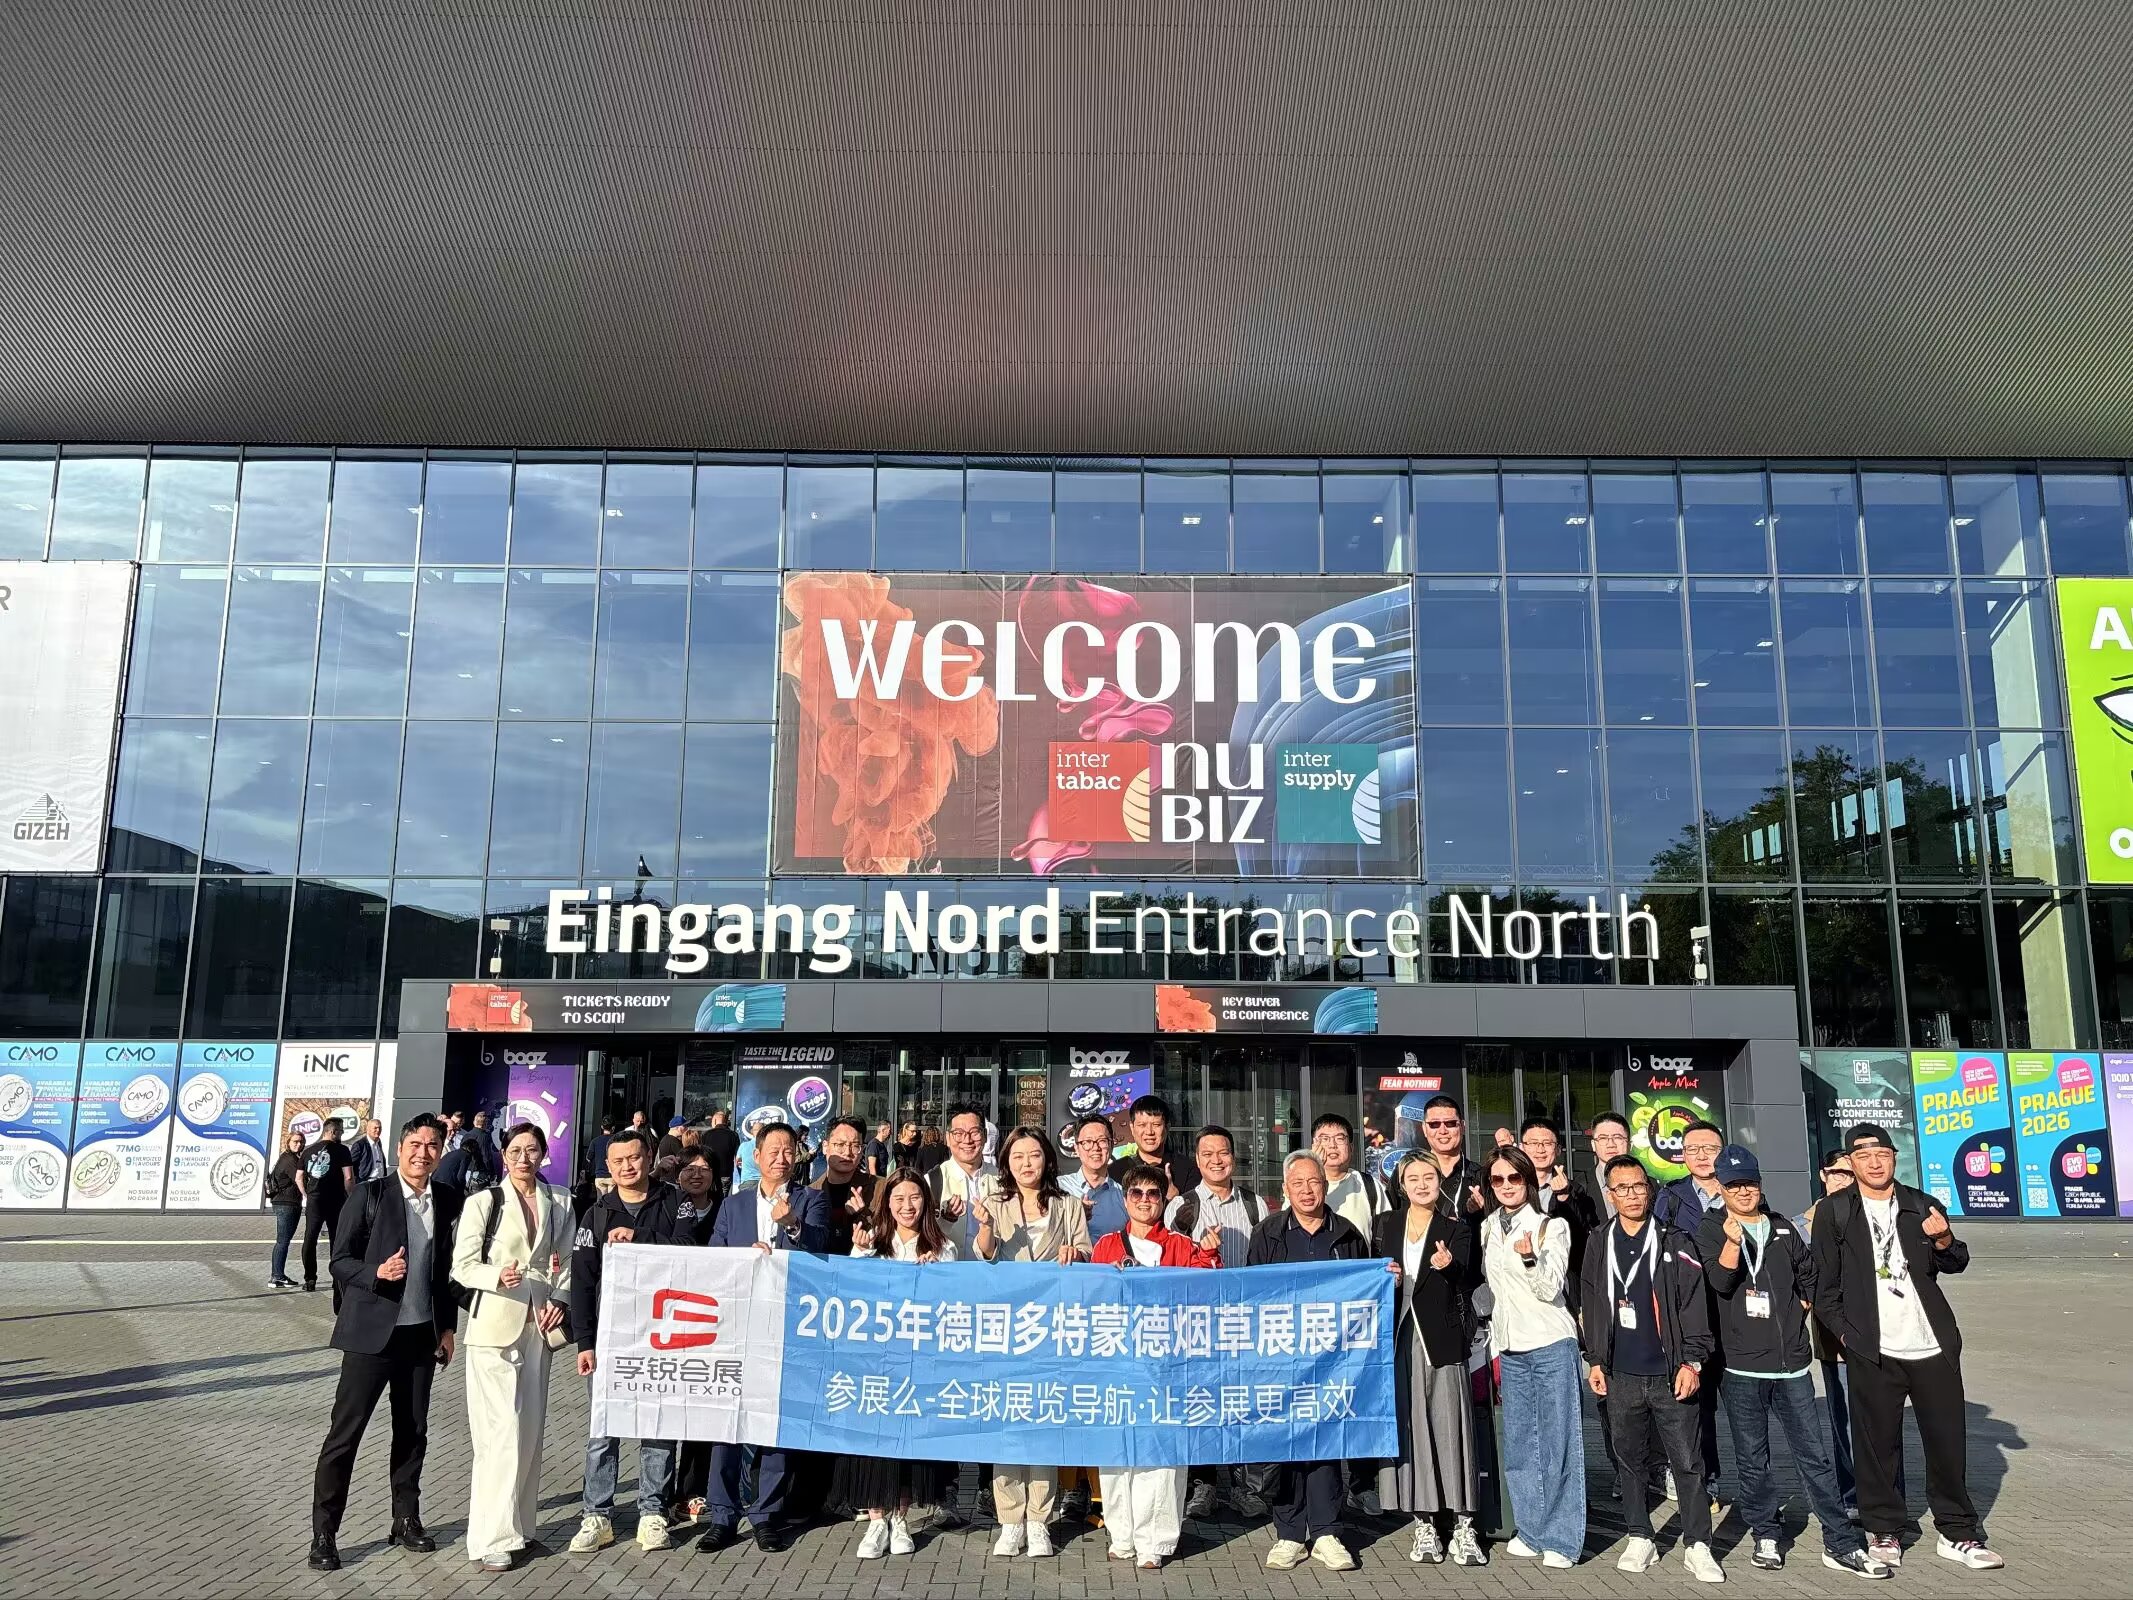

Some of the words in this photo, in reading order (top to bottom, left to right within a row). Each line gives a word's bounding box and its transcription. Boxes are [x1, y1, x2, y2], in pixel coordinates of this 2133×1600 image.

[2089, 606, 2133, 650] A
[1056, 749, 1110, 768] inter
[1283, 750, 1332, 767] inter
[1056, 771, 1121, 790] tabac
[1283, 771, 1357, 791] supply
[1161, 794, 1265, 843] BIZ
[13, 823, 70, 841] GIZEH
[545, 886, 855, 974] Eingang
[884, 887, 1060, 955] Nord
[1087, 889, 1421, 959] Entrance
[1450, 893, 1661, 961] North
[562, 995, 622, 1007] TICKETS
[715, 1000, 738, 1009] supply
[1222, 997, 1243, 1007] KEY
[1245, 997, 1281, 1007] BUYER
[561, 1012, 581, 1024] TO
[1222, 1010, 1237, 1020] CB
[1238, 1010, 1310, 1020] CONFERENCE
[8, 1046, 58, 1061] CAMO
[106, 1046, 155, 1061] CAMO
[203, 1047, 254, 1061] CAMO
[504, 1049, 547, 1069] bagz
[744, 1047, 767, 1056] TASTE
[768, 1046, 783, 1056] THE
[780, 1047, 835, 1062] LEGEND
[303, 1054, 350, 1072] iNIC
[1070, 1047, 1130, 1075] bagz
[1650, 1055, 1693, 1076] bagz
[1855, 1062, 1868, 1074] CB
[1069, 1069, 1106, 1077] ENERGY
[1382, 1079, 1402, 1088] FEAR
[1403, 1079, 1438, 1088] NOTHING
[1648, 1076, 1672, 1090] Apple
[1675, 1075, 1700, 1089] Mint
[36, 1087, 43, 1097] 7
[83, 1087, 92, 1097] 7
[127, 1090, 154, 1101] CAMO
[231, 1087, 240, 1098] 7
[1922, 1083, 2000, 1113] PRAGUE
[187, 1091, 214, 1112] CAMO
[1835, 1099, 1880, 1108] WELCOME
[1882, 1099, 1894, 1108] TO
[2020, 1084, 2096, 1115] PRAGUE
[1828, 1109, 1841, 1118] CB
[1842, 1109, 1903, 1118] CONFERENCE
[1832, 1120, 1853, 1128] AND
[1880, 1120, 1901, 1128] DIVE
[1924, 1110, 1974, 1135] 2026
[2022, 1111, 2070, 1136] 2026
[116, 1144, 141, 1153] 77MG
[175, 1145, 201, 1153] 77MG
[125, 1156, 132, 1166] 9
[173, 1157, 181, 1167] 9
[1969, 1155, 1986, 1165] EVO
[2066, 1156, 2082, 1166] EVO
[28, 1157, 55, 1187] CAMO
[77, 1157, 109, 1181] CAMO
[221, 1162, 254, 1185] CAMO
[1970, 1163, 1985, 1173] NXT
[2067, 1164, 2082, 1174] NXT
[796, 1295, 1378, 1358] 2025年德国多特蒙德烟草展展团
[613, 1382, 676, 1393] FURUI
[689, 1385, 743, 1396] EXPO
